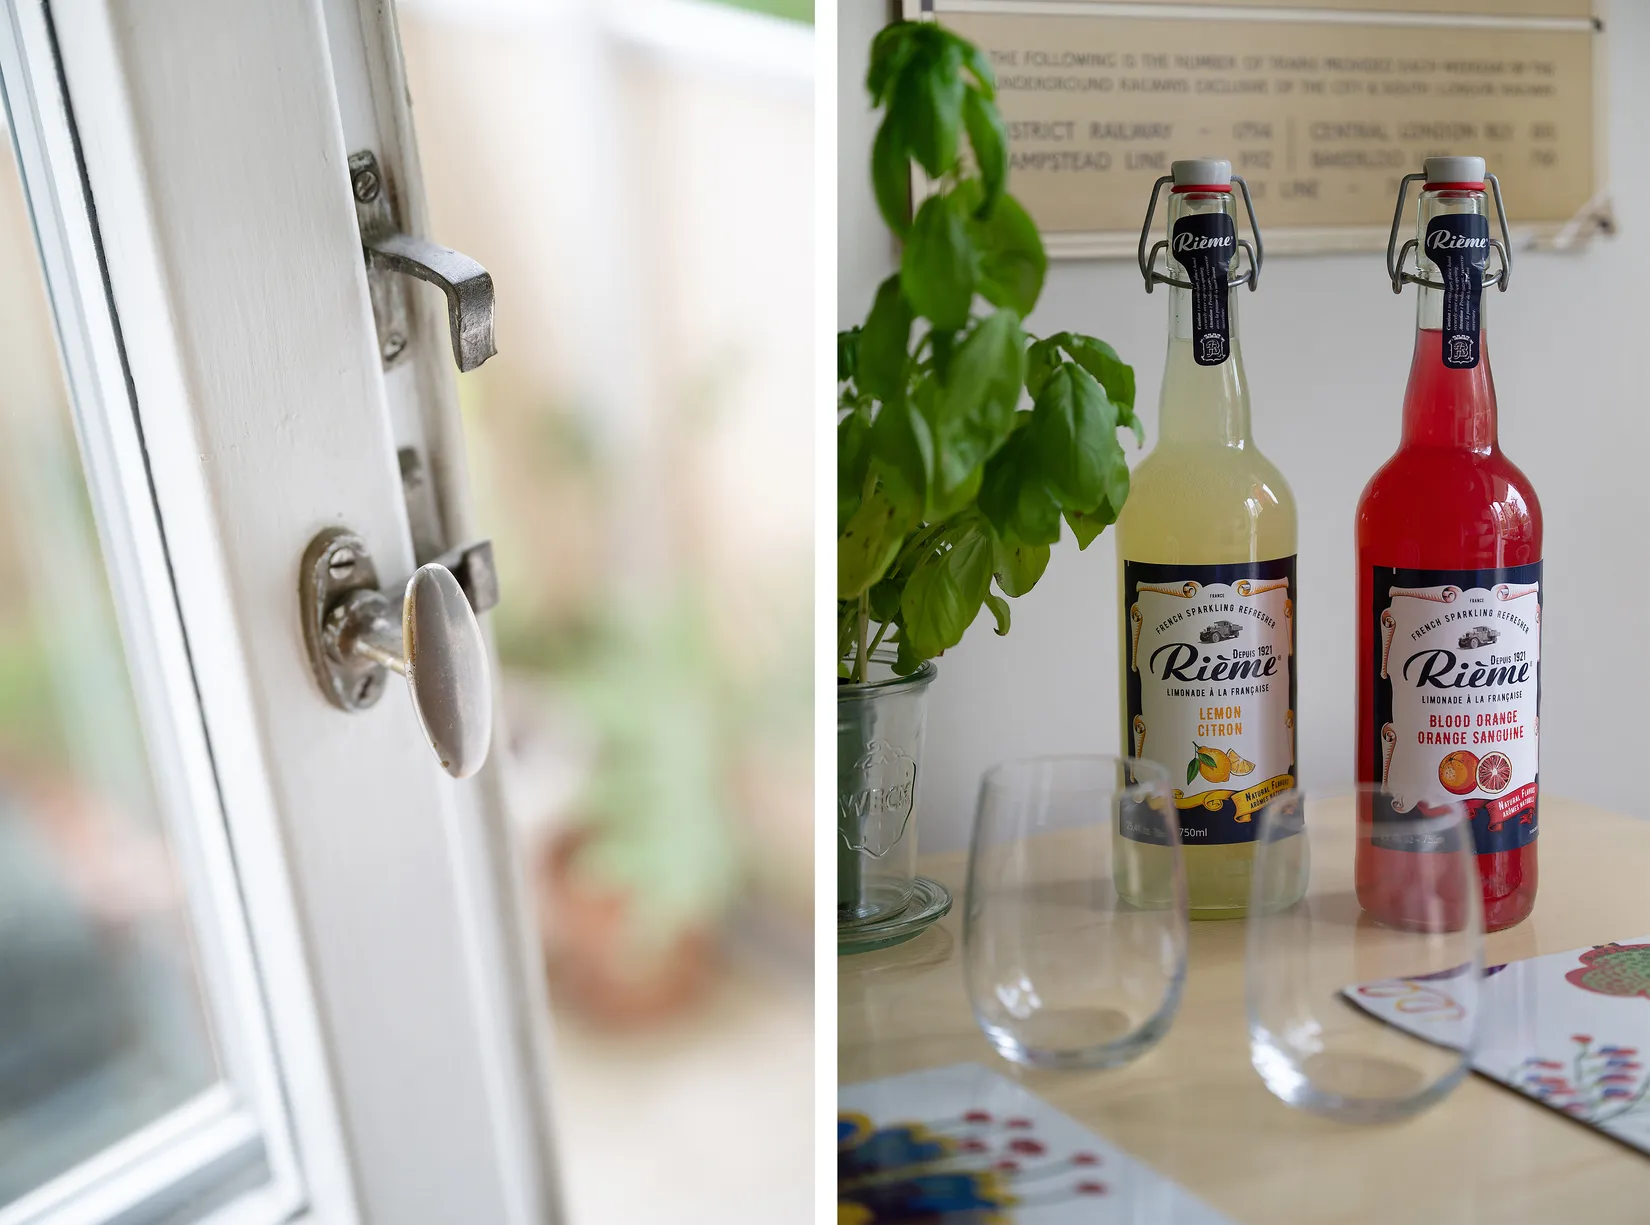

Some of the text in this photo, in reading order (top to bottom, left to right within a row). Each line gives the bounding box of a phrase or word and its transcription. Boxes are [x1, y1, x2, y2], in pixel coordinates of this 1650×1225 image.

[1023, 51, 1117, 69] FOLLOWING
[1088, 121, 1173, 140] RAILWAY
[1173, 232, 1231, 252] Rième
[1426, 229, 1487, 250] Rième
[1155, 603, 1276, 635] FRENCH SPARKLING REFRESHER
[1411, 609, 1530, 642] FRENCH SPARKLING REFRESHER
[1257, 645, 1273, 657] 1921
[1513, 650, 1526, 663] 1921
[1150, 642, 1278, 682] Rième
[1402, 649, 1530, 690] Rième
[1166, 684, 1270, 698] LIMONADE À LA FRANÇAISE
[1421, 690, 1523, 705] LIMONADE À LA FRANÇAISE
[1199, 705, 1242, 721] LEMON
[1429, 709, 1518, 729] BLOOD ORANGE
[1197, 722, 1243, 738] CITRON
[1417, 725, 1524, 746] ORANGE SANGUINE
[838, 781, 912, 818] WECK
[1178, 827, 1208, 838] 750ml
